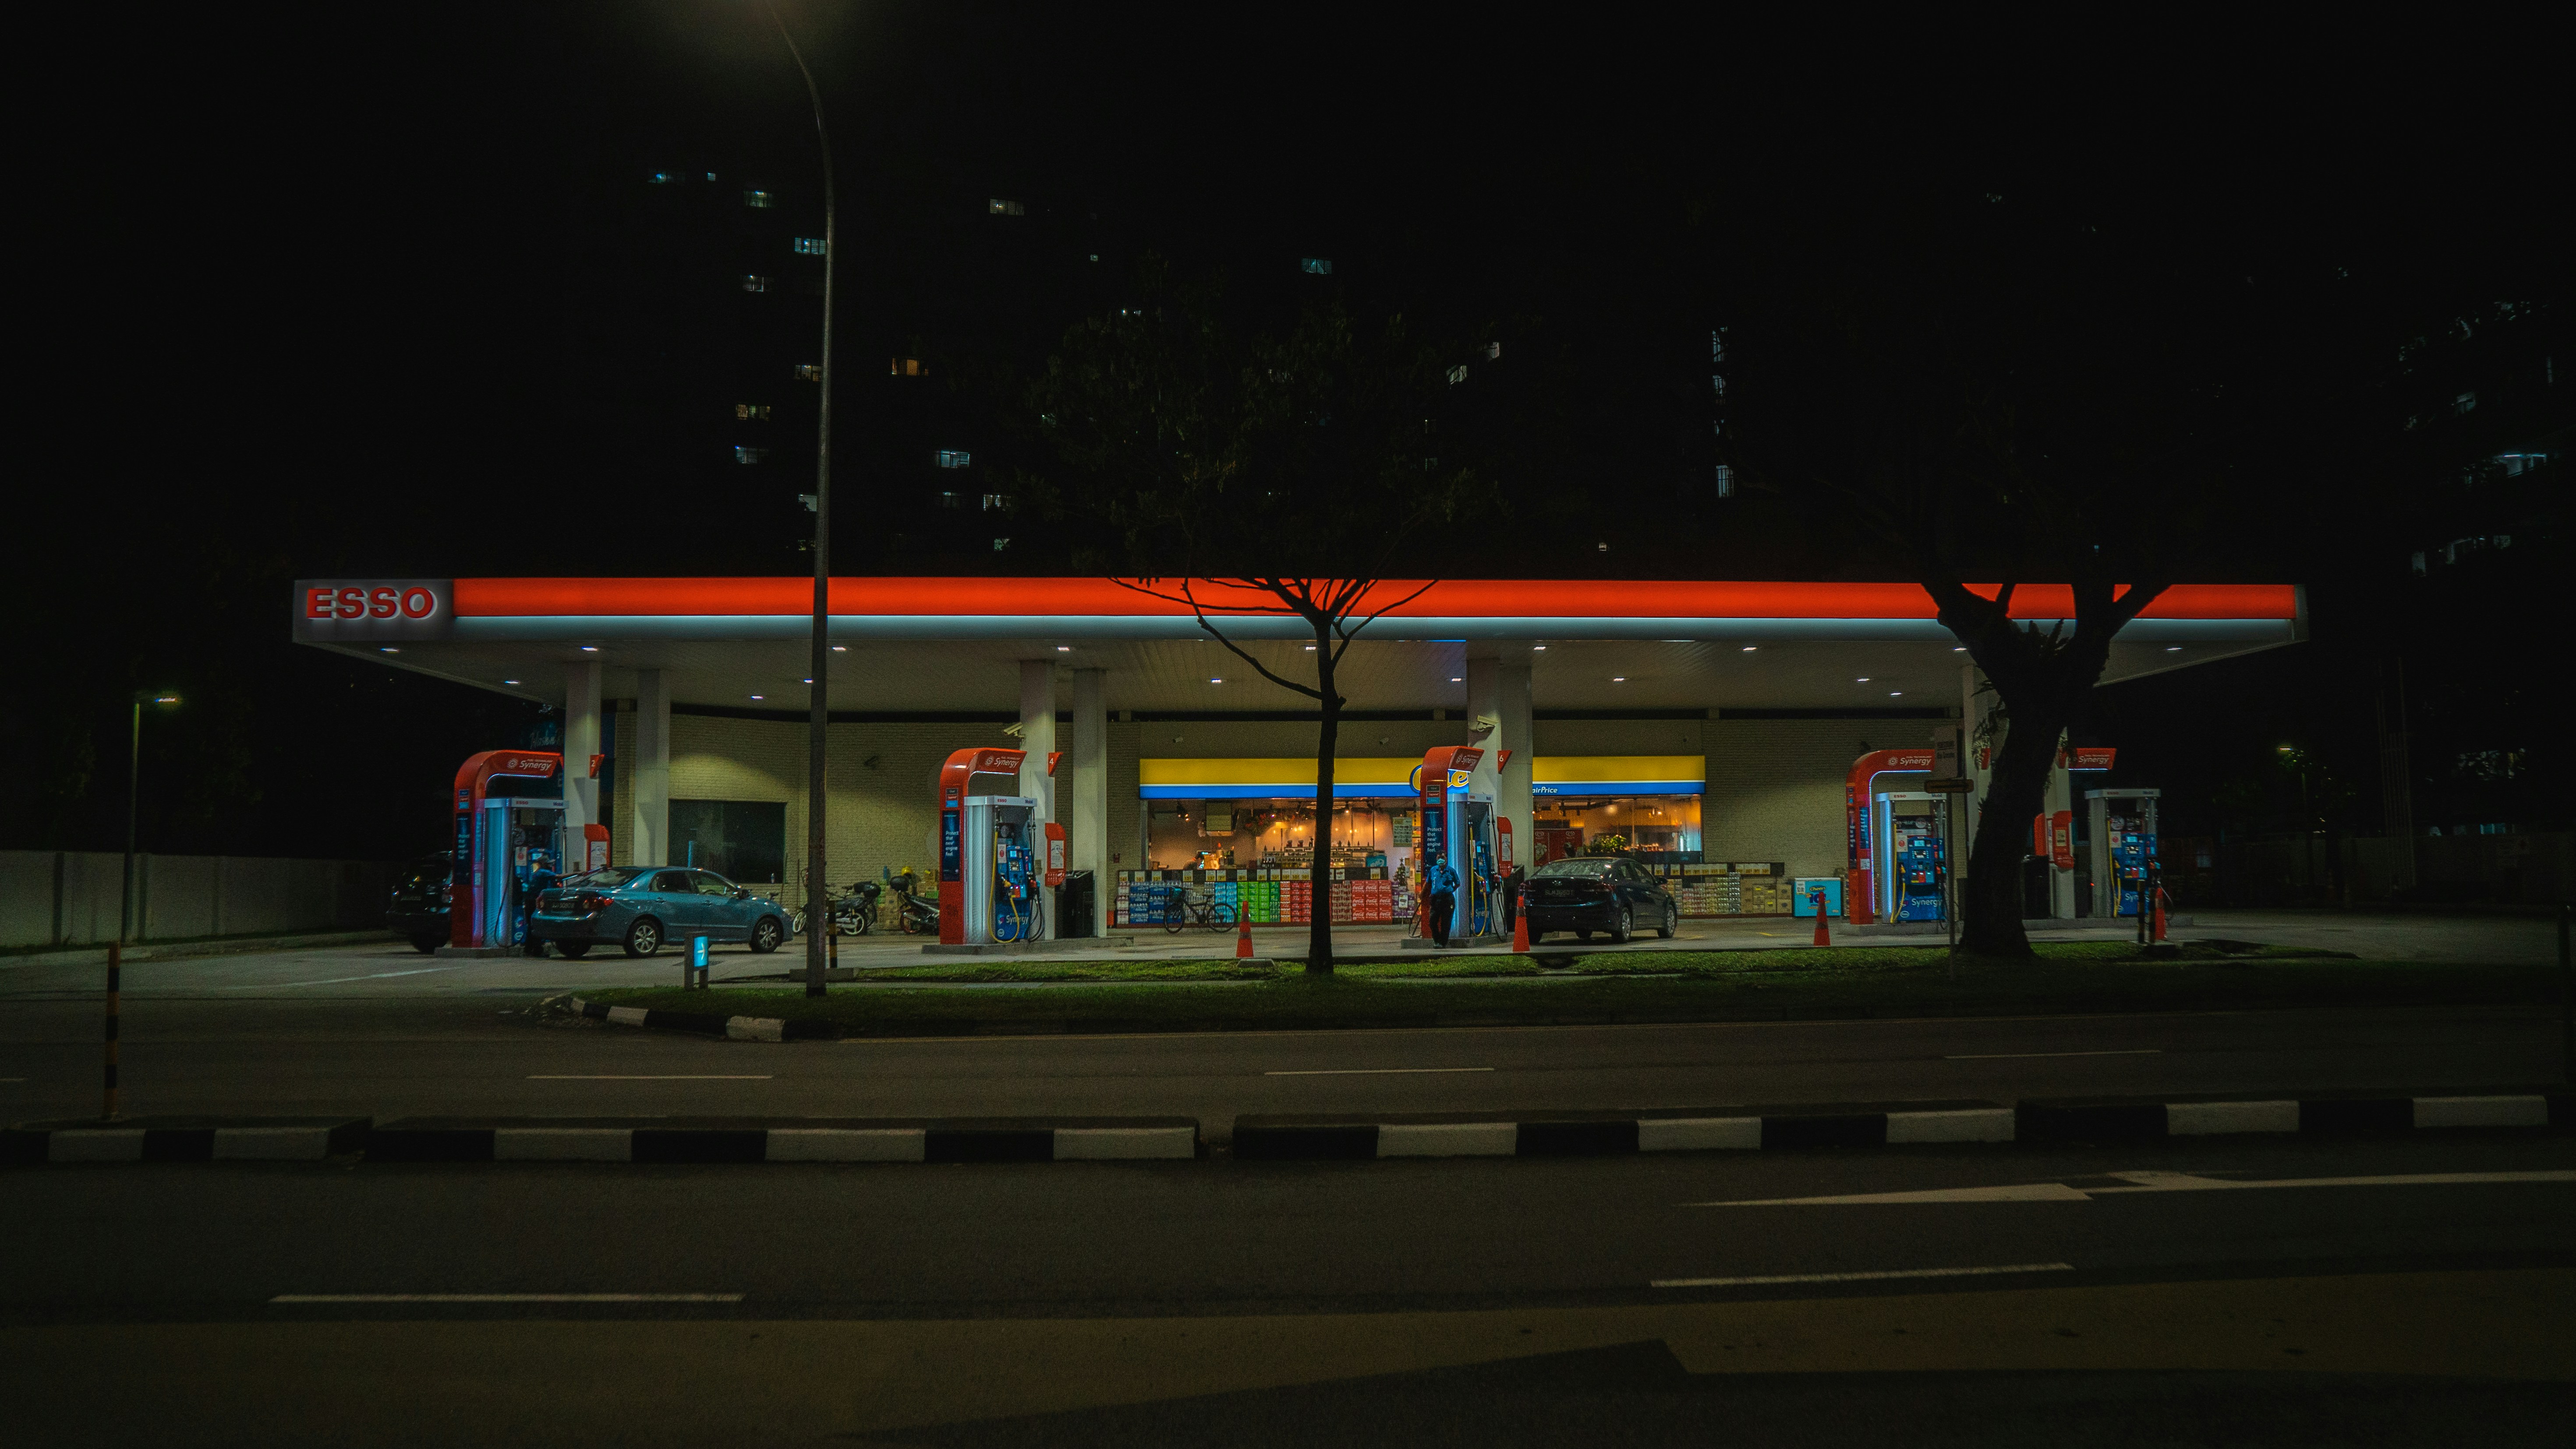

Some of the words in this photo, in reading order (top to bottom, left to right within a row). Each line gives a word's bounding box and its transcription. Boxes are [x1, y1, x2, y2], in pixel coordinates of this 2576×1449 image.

[307, 587, 437, 619] ESSO
[519, 760, 551, 771] Synergy
[994, 757, 1019, 768] Synergy
[1461, 756, 1478, 766] Synergy
[1900, 757, 1931, 766] Synergy
